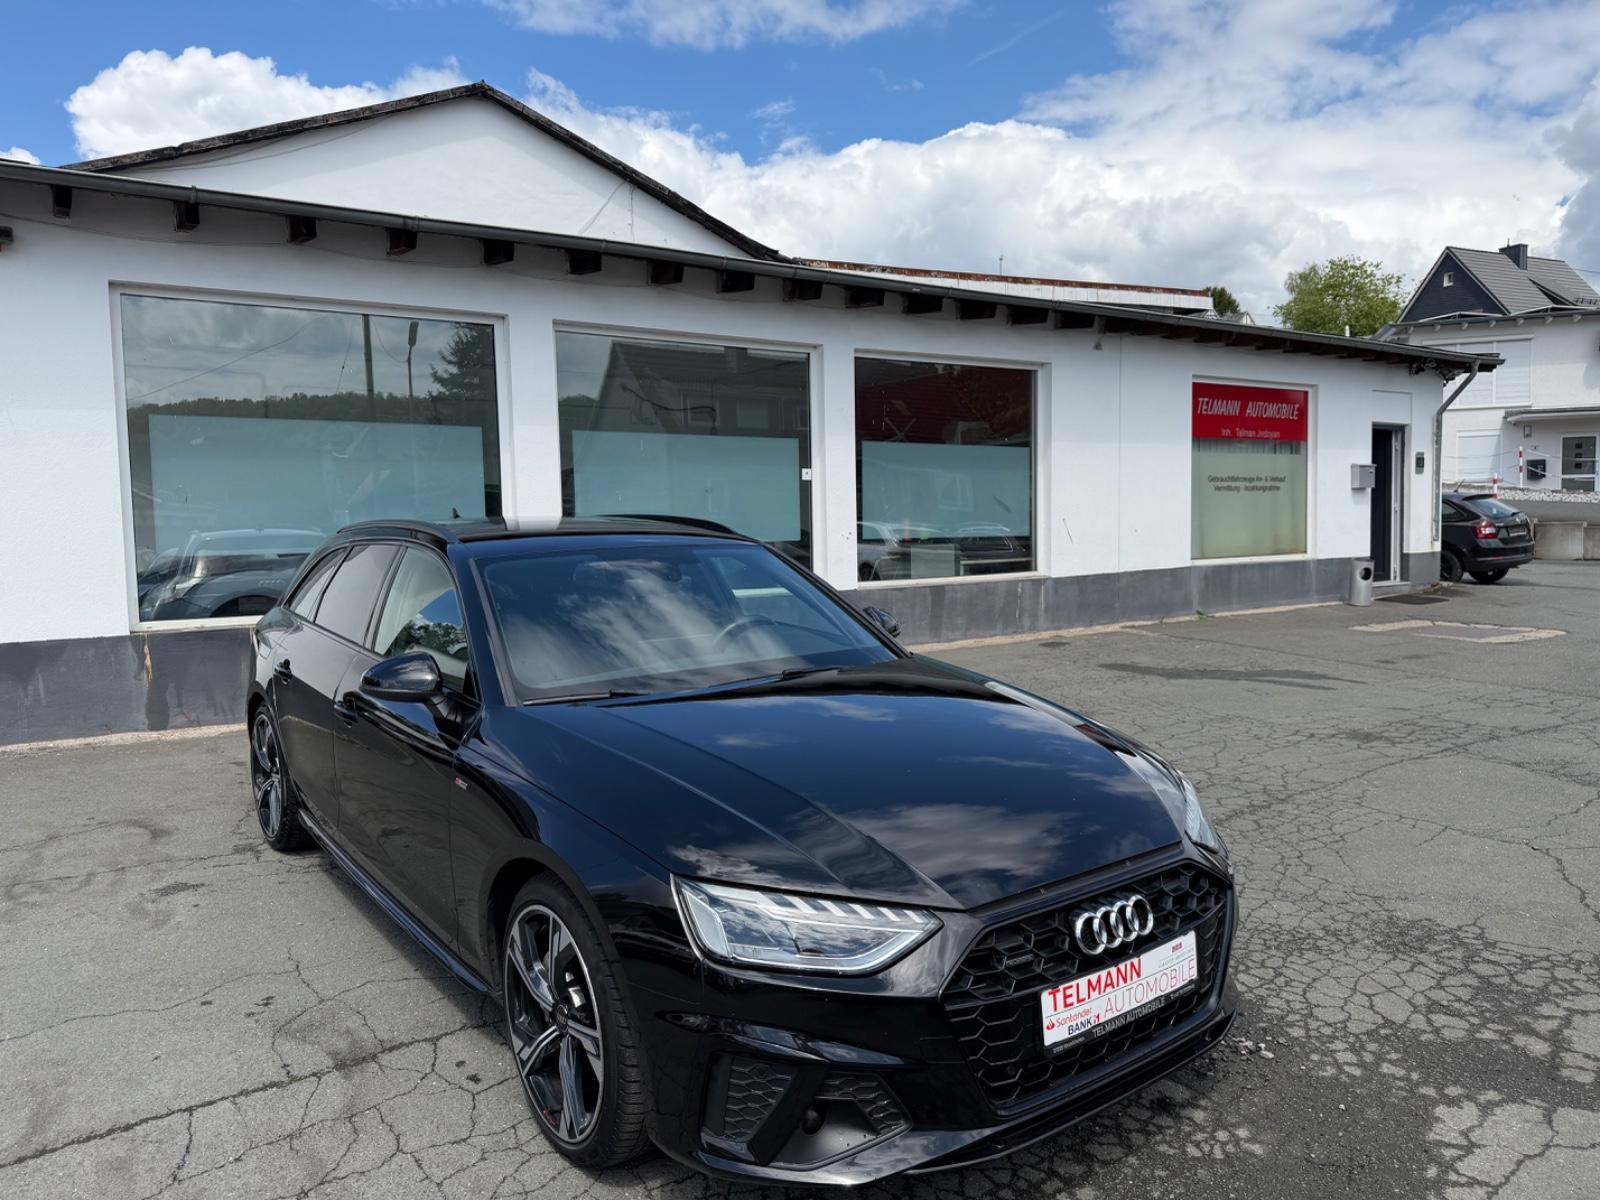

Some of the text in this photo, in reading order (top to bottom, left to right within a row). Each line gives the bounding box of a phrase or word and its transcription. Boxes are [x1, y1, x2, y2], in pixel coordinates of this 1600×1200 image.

[1198, 398, 1300, 420] TELMANN AUTOMOBILE
[1048, 957, 1143, 1012] TELMANN
[1104, 958, 1195, 1017] AUTOMOBILE
[1056, 1007, 1092, 1028] Santander
[1092, 996, 1165, 1038] TELMANN AUTOMOBILE
